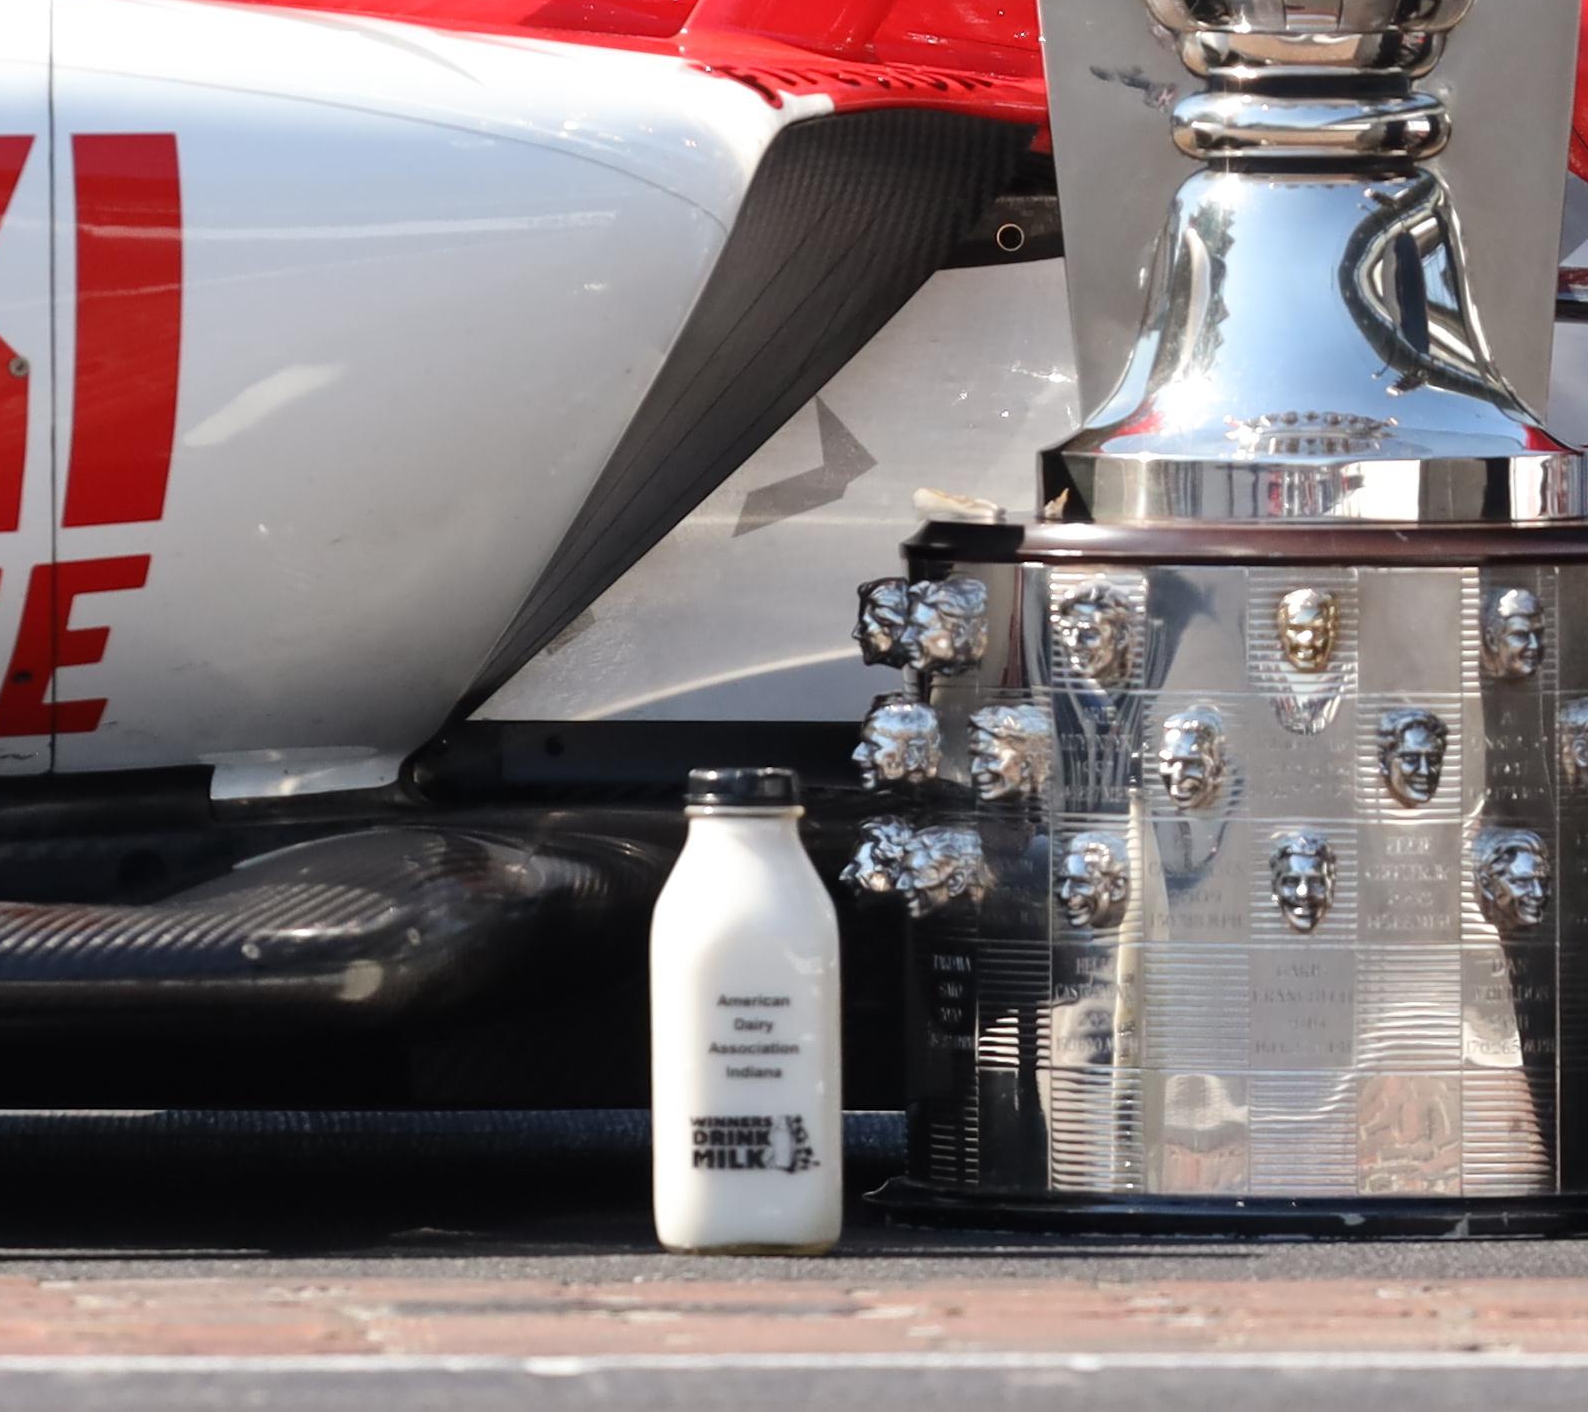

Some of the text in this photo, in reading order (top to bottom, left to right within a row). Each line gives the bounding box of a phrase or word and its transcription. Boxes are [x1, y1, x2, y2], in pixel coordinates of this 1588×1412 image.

[717, 995, 790, 1007] American
[734, 1018, 774, 1033] Dairy
[709, 1043, 799, 1055] Association
[726, 1066, 782, 1078] Indiana
[691, 1117, 773, 1128] WINNERS
[693, 1130, 771, 1146] DRINK
[693, 1149, 767, 1169] MILK
